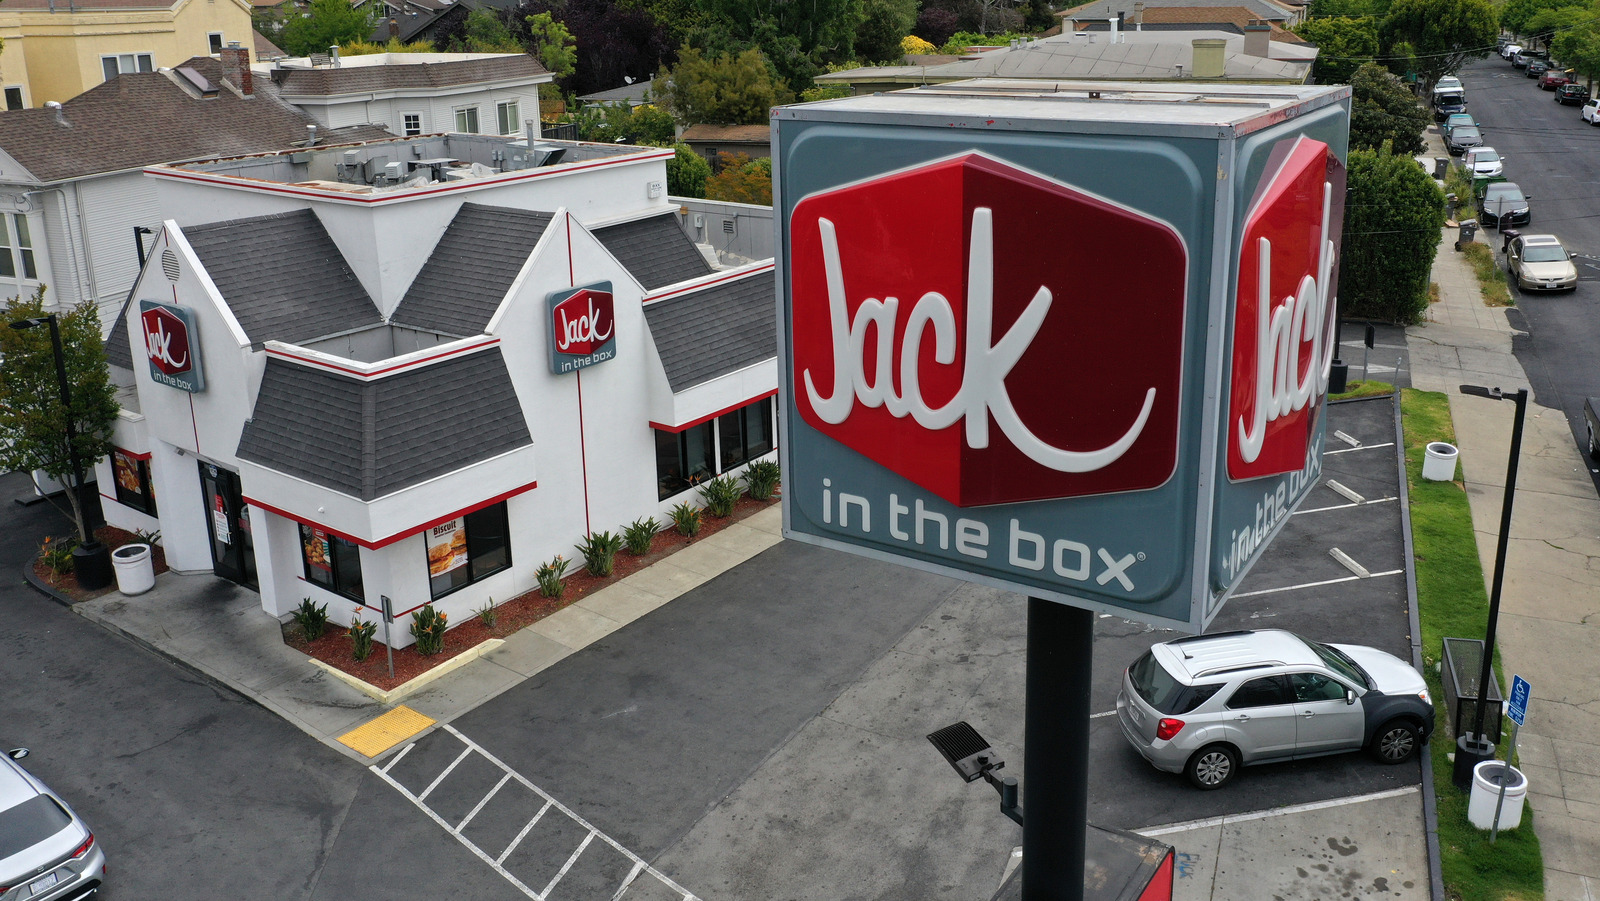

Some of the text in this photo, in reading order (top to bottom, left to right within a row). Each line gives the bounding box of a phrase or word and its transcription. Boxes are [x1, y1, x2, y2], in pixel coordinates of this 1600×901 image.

[143, 316, 187, 368] Jack
[558, 298, 613, 349] Jack
[803, 207, 1156, 473] Jack
[153, 370, 193, 391] in the box
[561, 350, 612, 372] in the box
[433, 520, 457, 536] Biscuit
[822, 477, 871, 533] in
[889, 493, 990, 559] the
[1230, 529, 1251, 580] in
[1255, 480, 1286, 548] the
